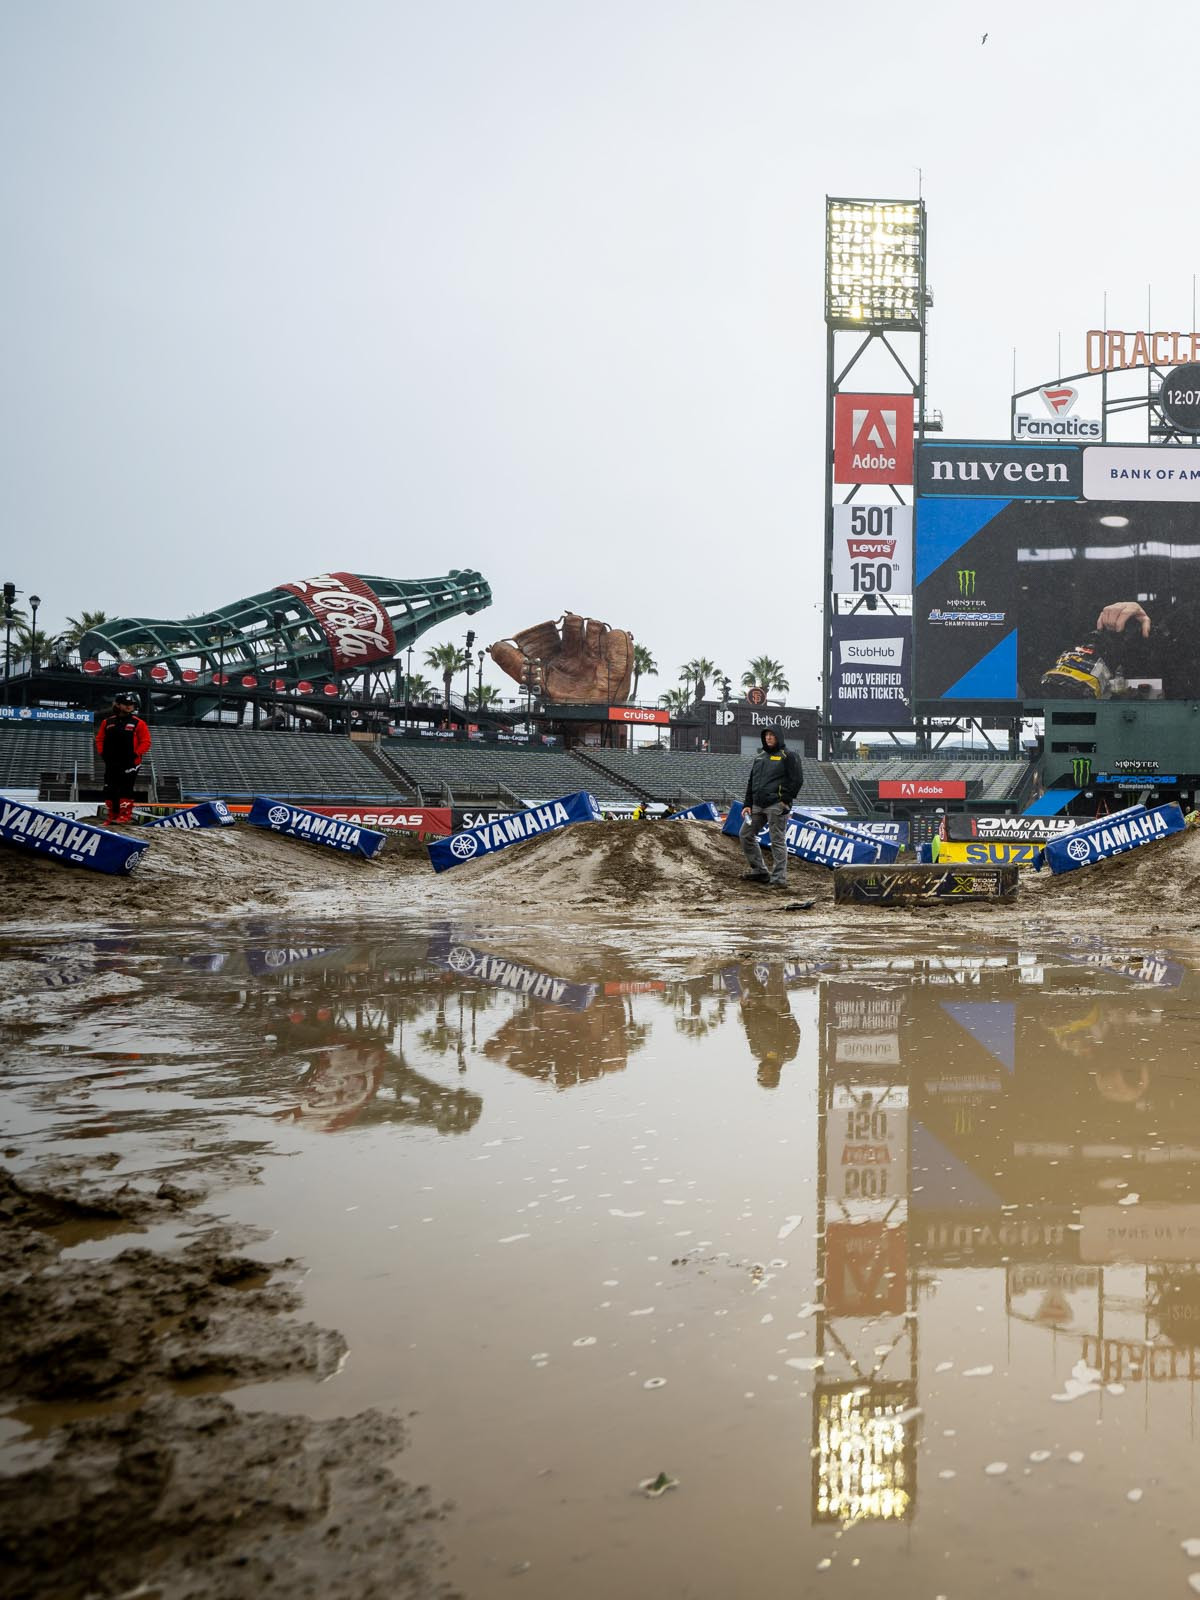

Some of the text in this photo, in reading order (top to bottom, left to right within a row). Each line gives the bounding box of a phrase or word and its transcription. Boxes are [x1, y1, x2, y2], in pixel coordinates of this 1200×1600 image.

[1167, 390, 1200, 406] 12:07
[1017, 417, 1099, 437] Fanatics
[852, 454, 897, 469] Adobe
[931, 459, 1070, 482] nuveen
[1110, 469, 1175, 480] BANK OF
[851, 506, 893, 536] 501
[928, 612, 1006, 620] SUPERCROSS
[848, 646, 895, 657] StubHub
[841, 673, 902, 685] 100% VERIFIED
[838, 687, 904, 700] GIANTS TICKETS
[36, 710, 90, 721] ualocal38.org
[623, 711, 655, 720] cruise
[774, 714, 800, 729] Coffee
[1115, 759, 1160, 769] MONSTER
[1096, 775, 1178, 784] SUPERCROSS
[917, 786, 944, 794] Adobe
[0, 803, 102, 857] YAMAHA
[289, 811, 361, 846] YAMAHA
[476, 802, 569, 849] YAMAHA
[1088, 811, 1168, 853] YAMAHA
[271, 824, 352, 850] RACING
[978, 829, 1031, 839] MOUNTAIN
[785, 822, 855, 864] AMAHA
[1081, 833, 1166, 867] RACING
